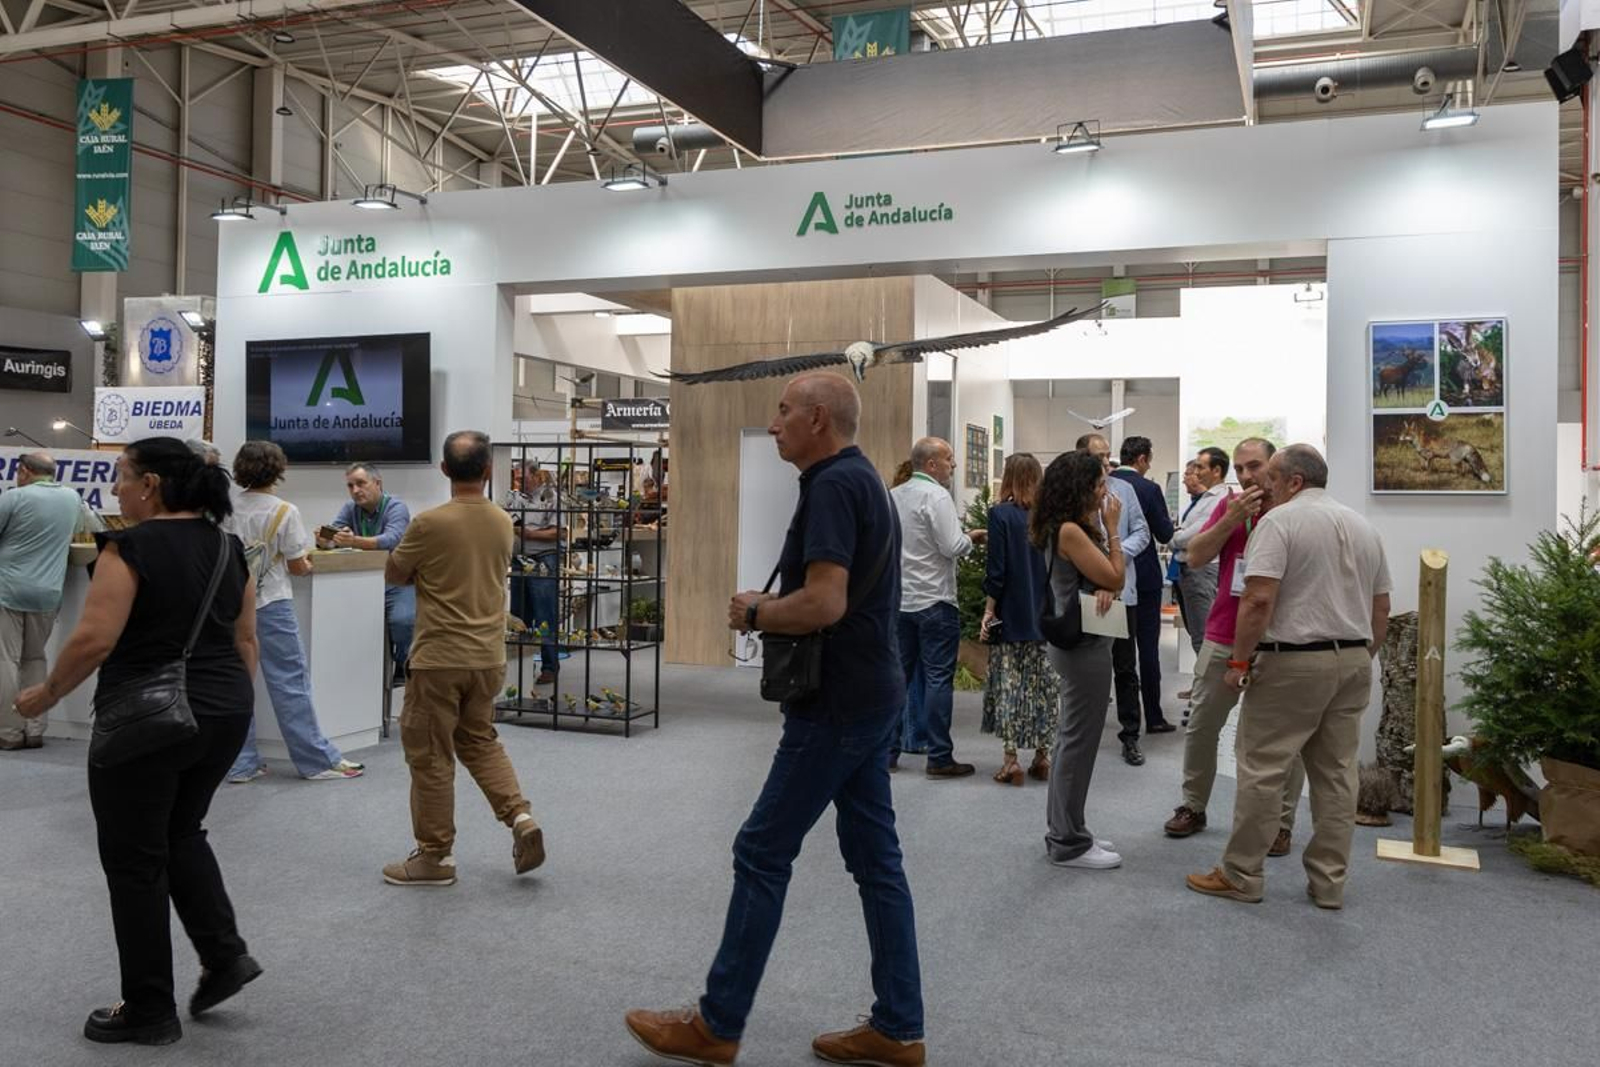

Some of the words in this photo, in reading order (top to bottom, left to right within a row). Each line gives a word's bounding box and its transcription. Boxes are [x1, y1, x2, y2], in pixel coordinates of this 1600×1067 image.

[100, 134, 128, 143] RURAL
[844, 192, 892, 210] Junta
[844, 210, 865, 228] de
[868, 202, 954, 226] Andalucía
[97, 231, 125, 240] RURAL
[318, 234, 377, 256] Junta
[317, 260, 342, 282] de
[346, 250, 452, 281] Andalucía
[3, 358, 66, 379] Auringis
[131, 400, 203, 417] BIEDMA
[604, 402, 662, 417] Armería
[271, 416, 309, 430] Junta
[312, 415, 330, 430] de
[332, 411, 404, 430] Andalucía
